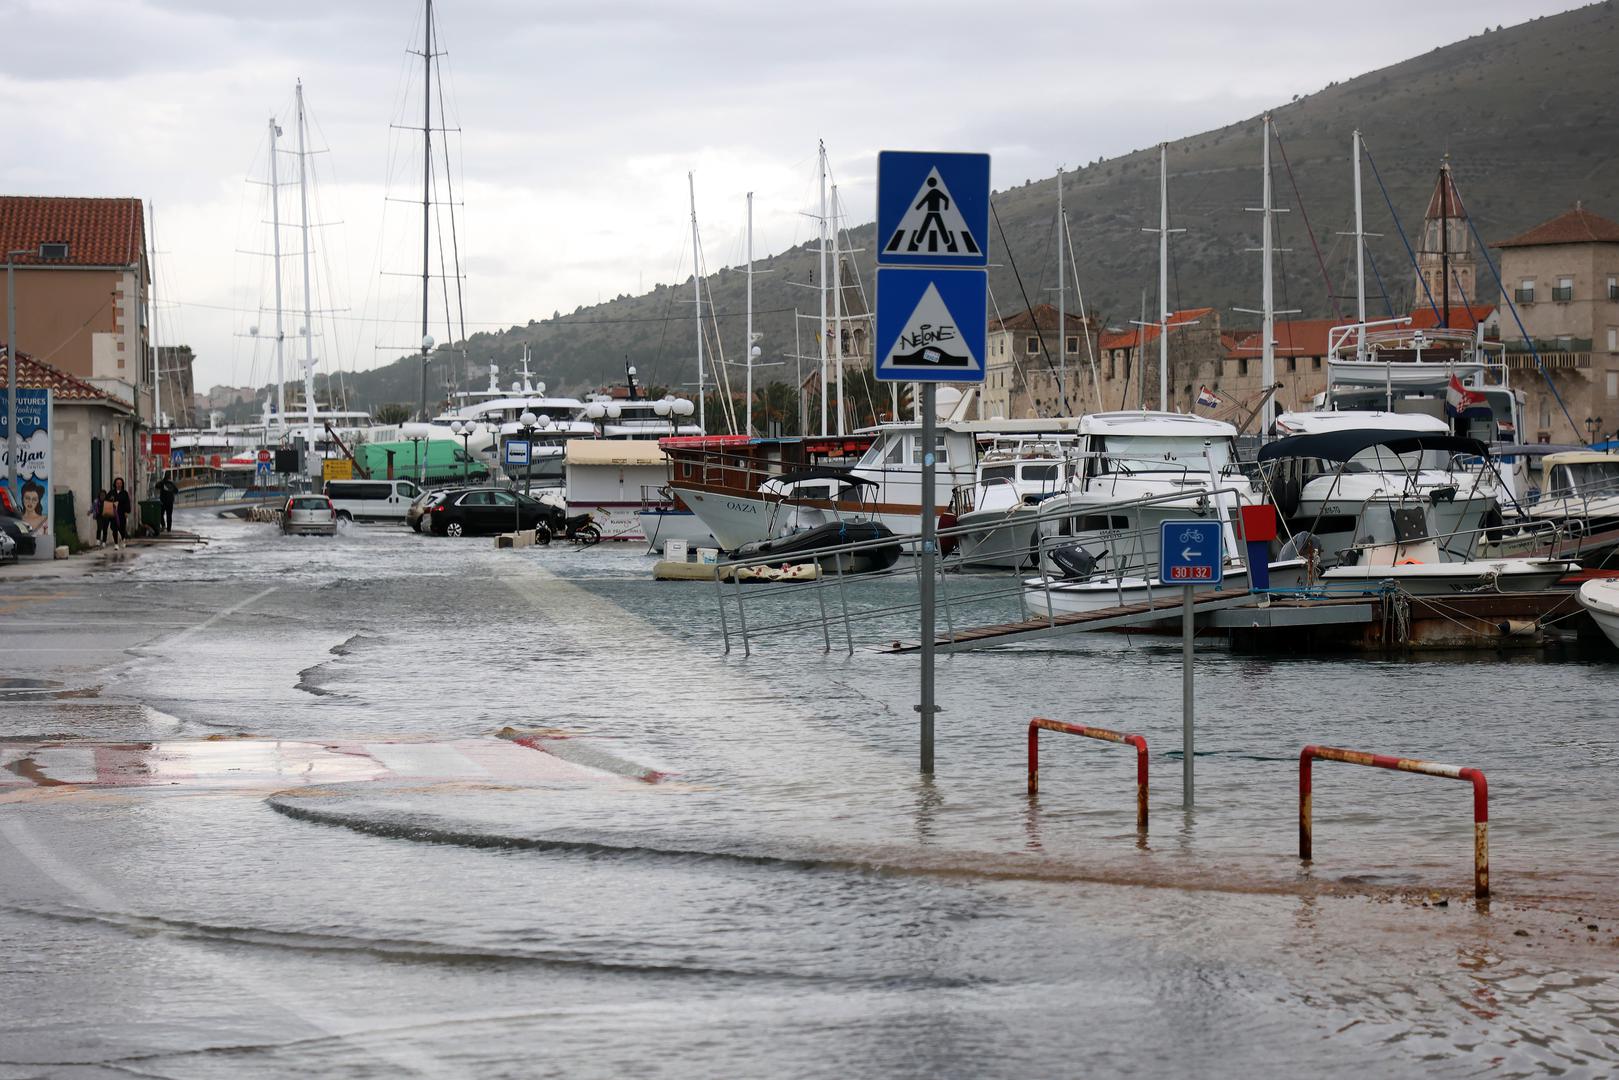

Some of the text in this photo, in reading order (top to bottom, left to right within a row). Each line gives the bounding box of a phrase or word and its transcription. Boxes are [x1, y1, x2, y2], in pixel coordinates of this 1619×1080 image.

[727, 501, 757, 514] OAZA
[1175, 567, 1207, 578] 30 32
